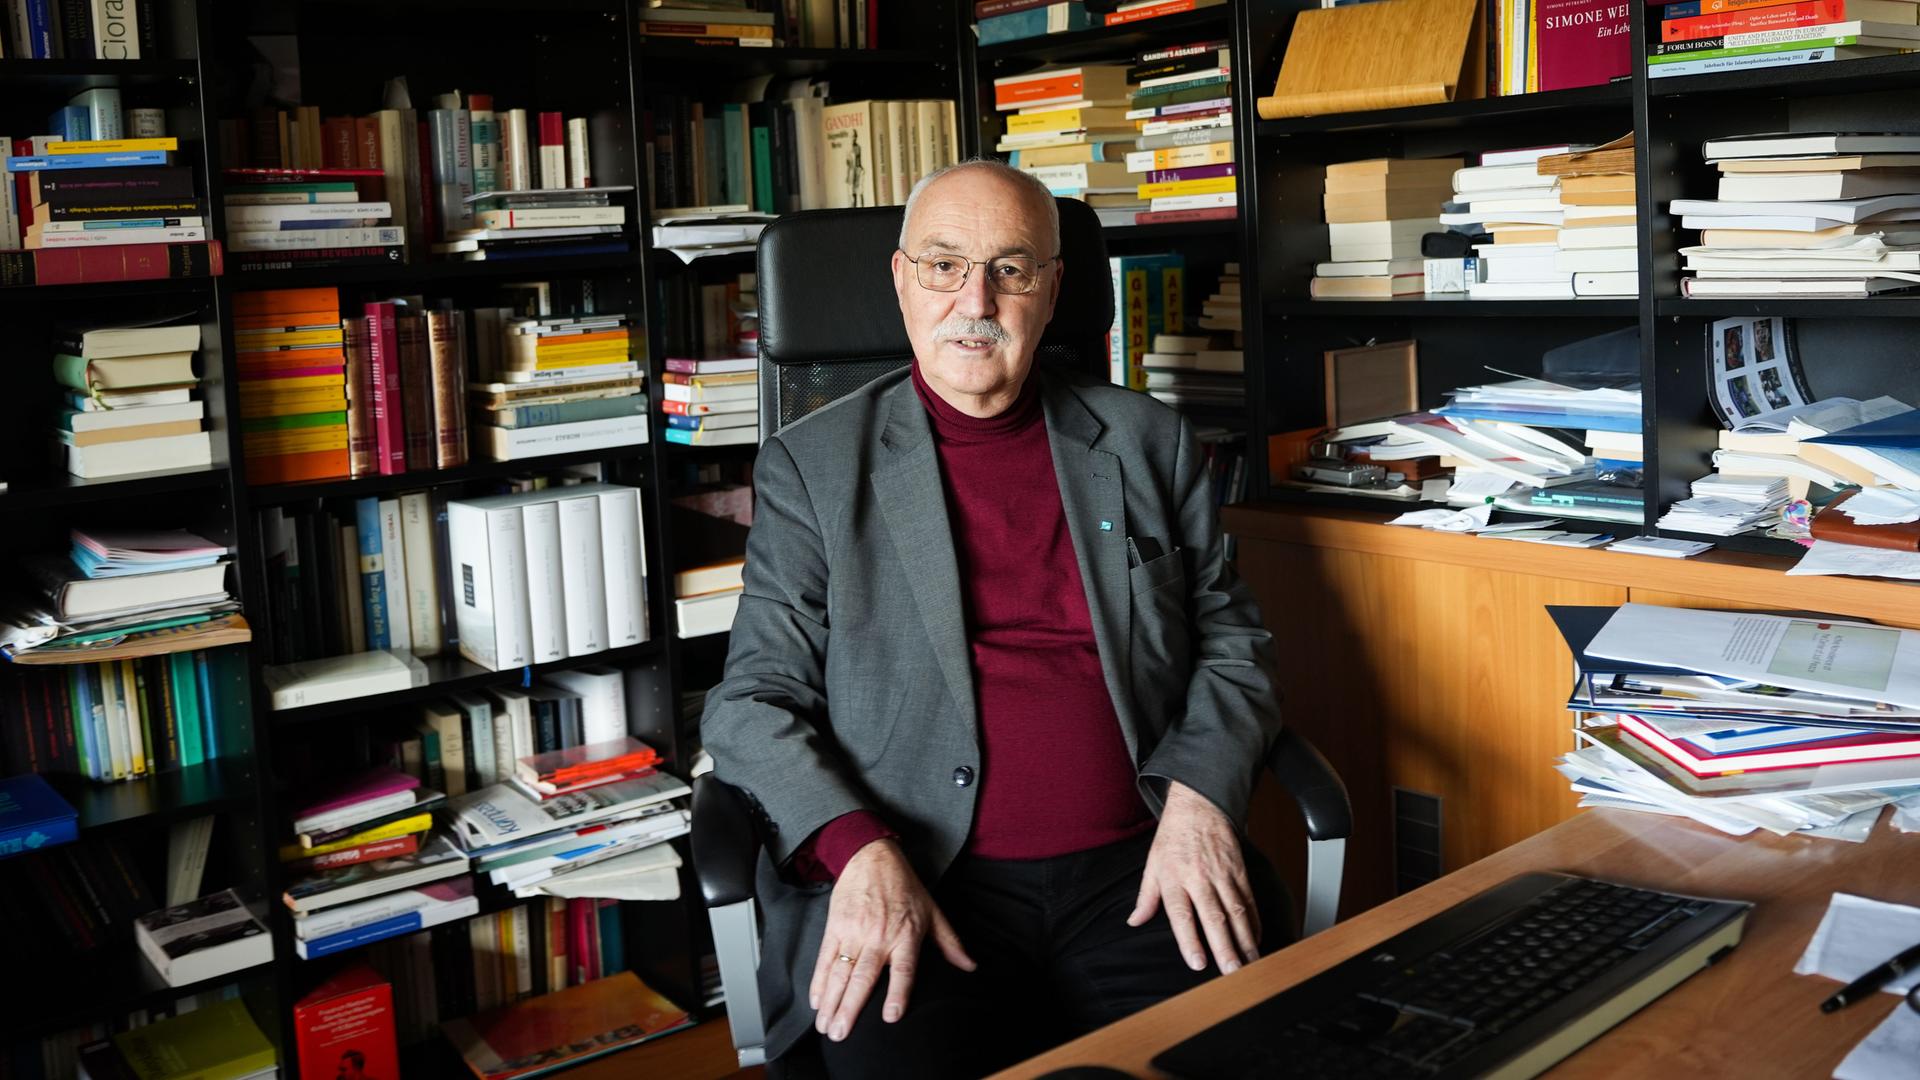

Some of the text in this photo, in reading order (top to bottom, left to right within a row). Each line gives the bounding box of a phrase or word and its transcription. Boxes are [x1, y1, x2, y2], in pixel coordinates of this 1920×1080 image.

[1546, 4, 1630, 30] SIMONE WEI
[1597, 26, 1613, 38] Ein
[1760, 29, 1791, 38] PLURALITY
[1173, 45, 1207, 59] ASSASSIN
[1667, 41, 1693, 52] FORUM
[1704, 60, 1724, 69] Jahrbuch
[1726, 58, 1734, 66] für
[825, 112, 863, 130] GANDHI
[457, 117, 468, 168] Kulturen
[1168, 274, 1177, 336] AFT
[1131, 278, 1143, 384] GANDHI
[1112, 336, 1120, 363] 9/11
[370, 574, 380, 588] Im
[371, 589, 381, 606] Zug
[373, 606, 383, 616] der
